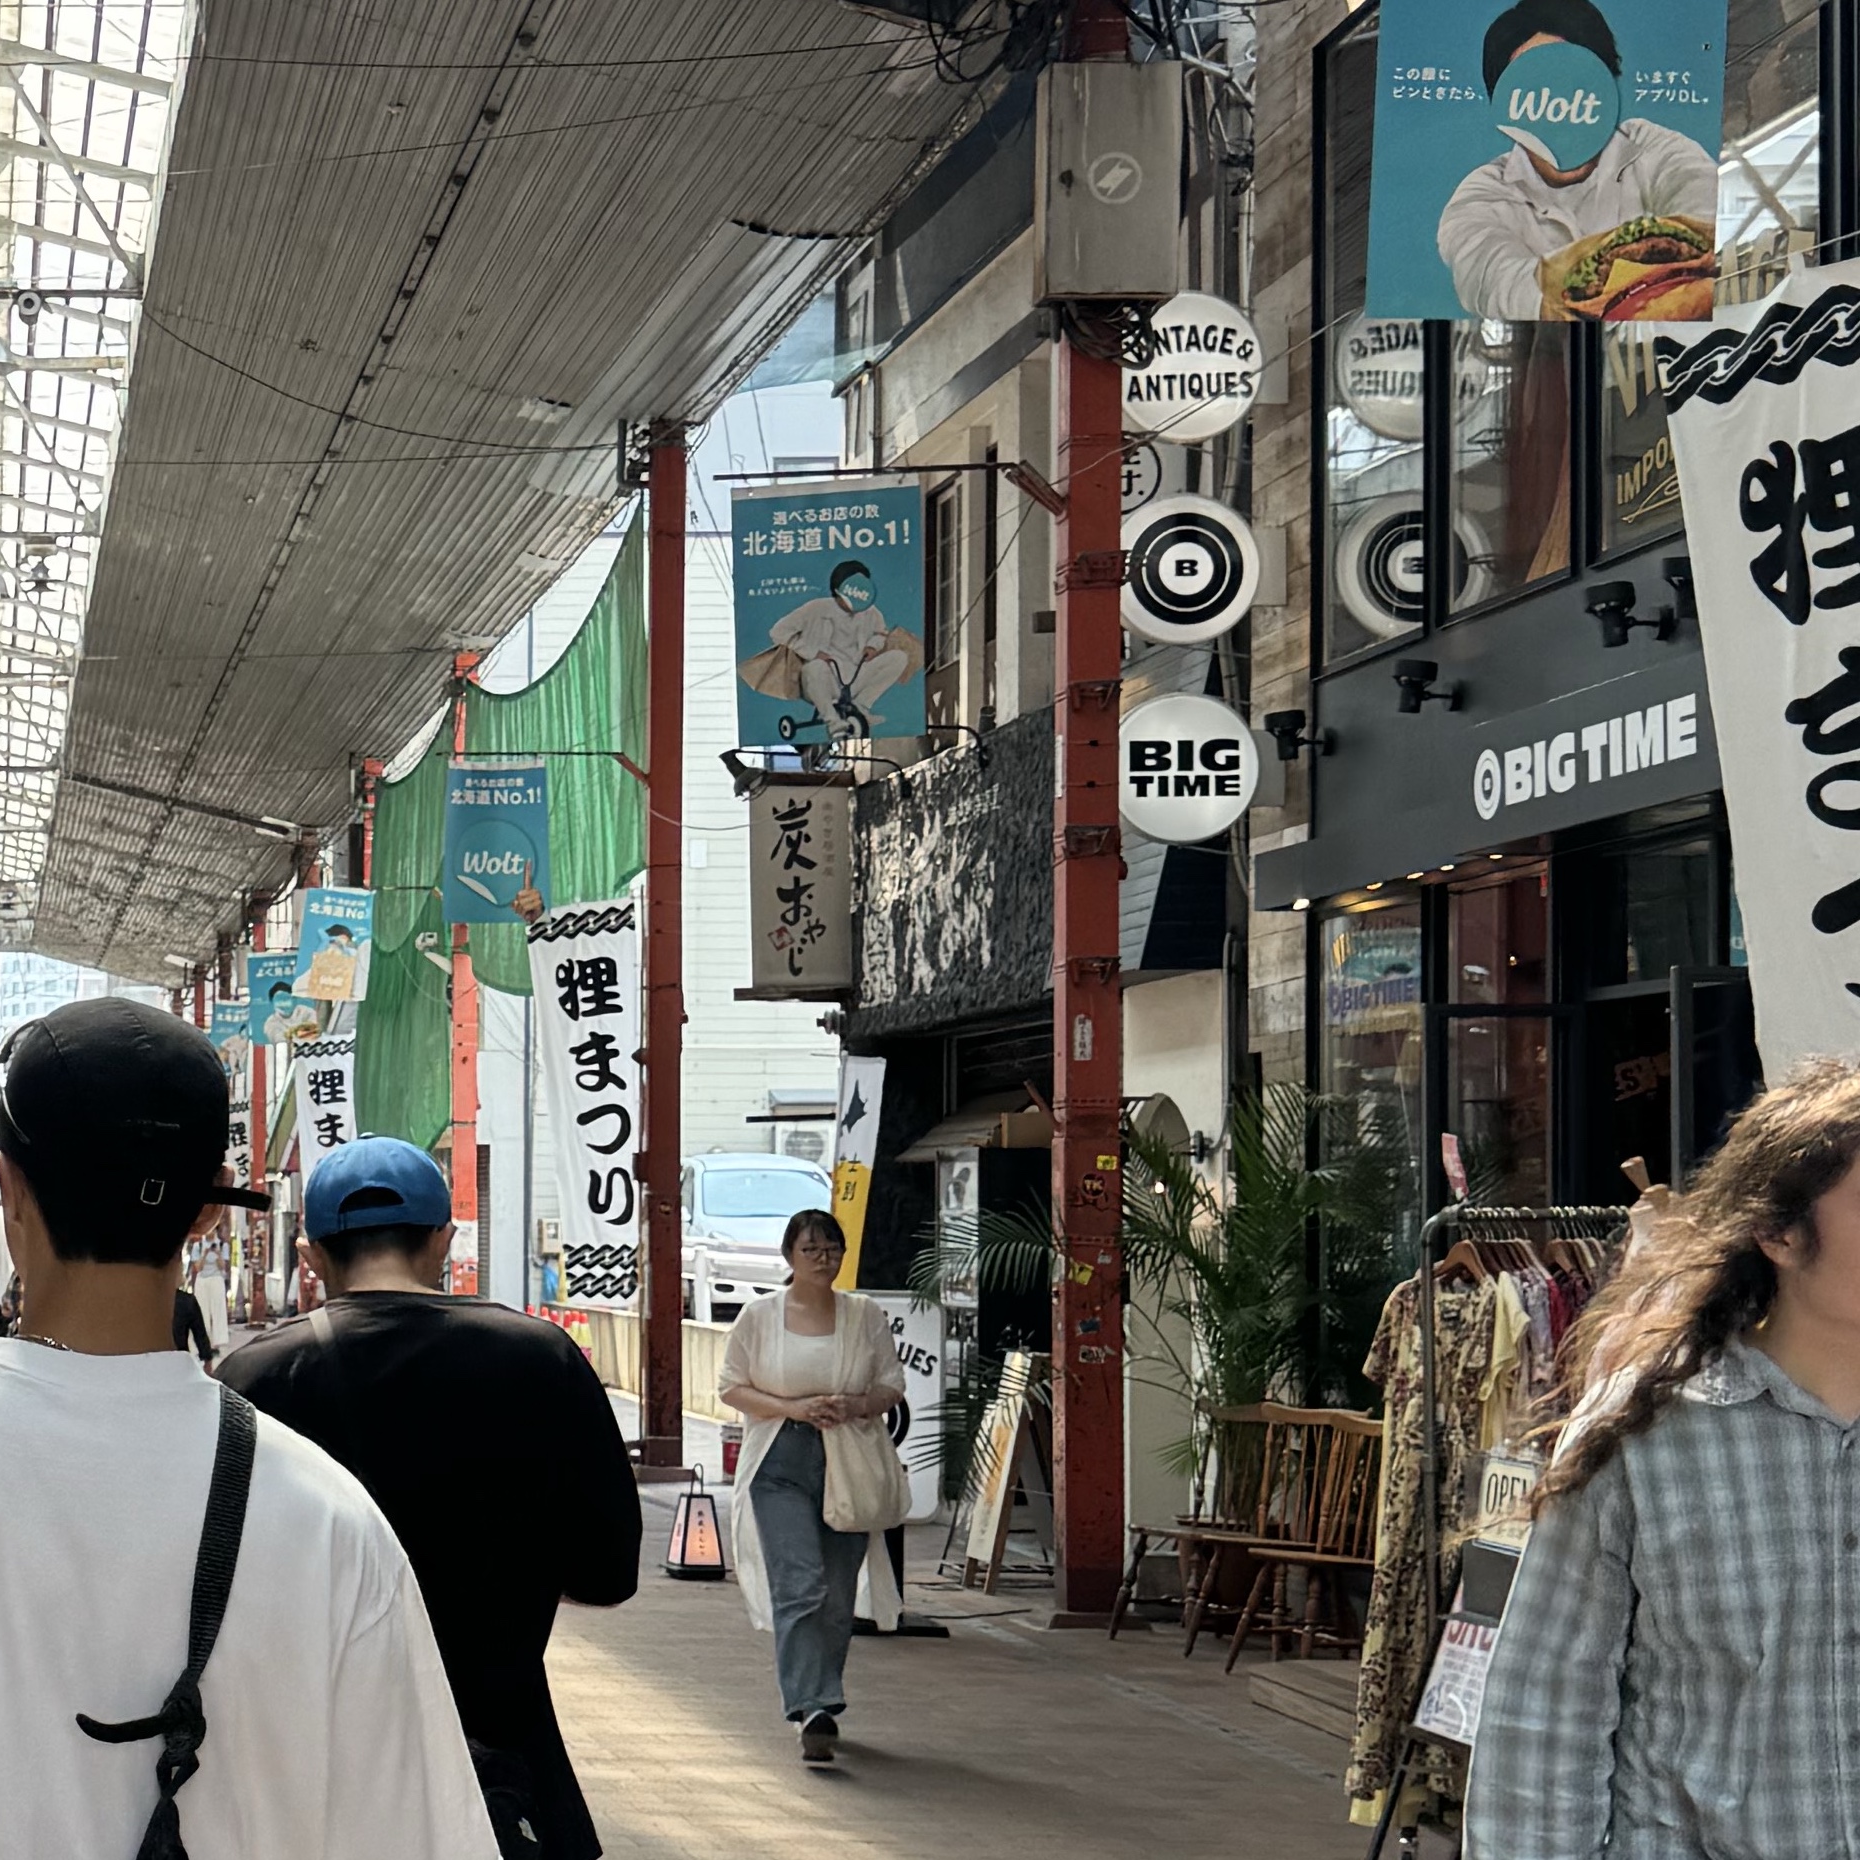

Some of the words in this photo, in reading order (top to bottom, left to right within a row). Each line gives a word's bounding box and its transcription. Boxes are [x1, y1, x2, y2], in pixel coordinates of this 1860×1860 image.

[1635, 70, 1692, 84] いますぐ
[1508, 86, 1602, 125] Wolt
[1634, 89, 1709, 106] アプリDL。
[1236, 338, 1254, 362] &
[1126, 371, 1254, 403] ANTIQUES
[1617, 436, 1676, 504] IMPO
[742, 518, 910, 557] 北海道No.1!
[1174, 559, 1200, 577] B
[1129, 738, 1241, 772] BIG
[1504, 731, 1576, 806] BIG
[1581, 692, 1697, 784] TIME
[1129, 775, 1241, 798] TIME
[463, 850, 525, 876] Wolt
[769, 797, 828, 977] 炭おやじ
[555, 956, 635, 1227] 狸まつり
